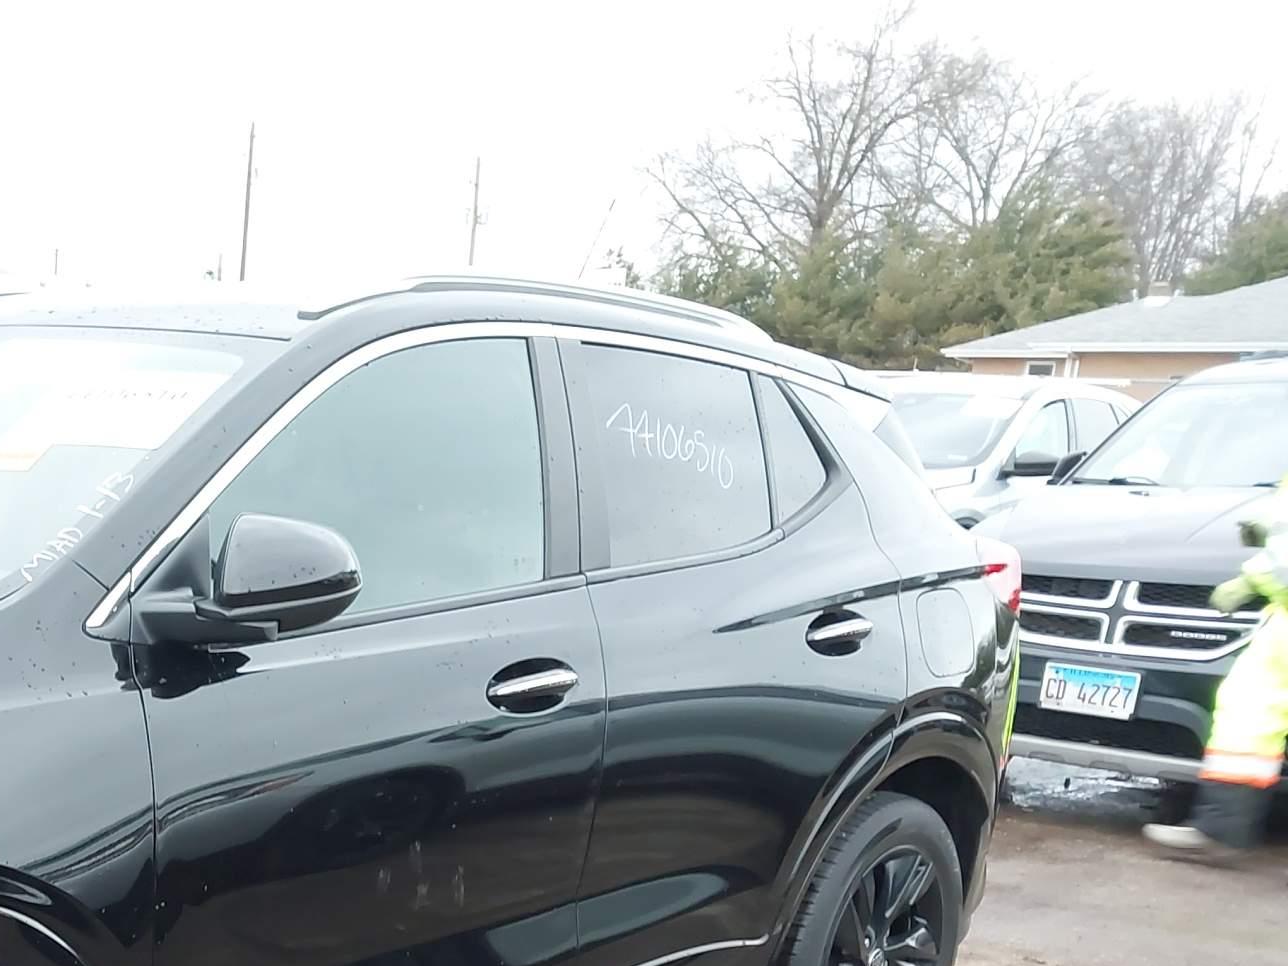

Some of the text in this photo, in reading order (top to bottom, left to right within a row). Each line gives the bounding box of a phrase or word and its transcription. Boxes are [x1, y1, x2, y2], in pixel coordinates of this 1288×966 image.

[606, 402, 734, 489] 44106510
[1045, 678, 1133, 710] CD 42727
